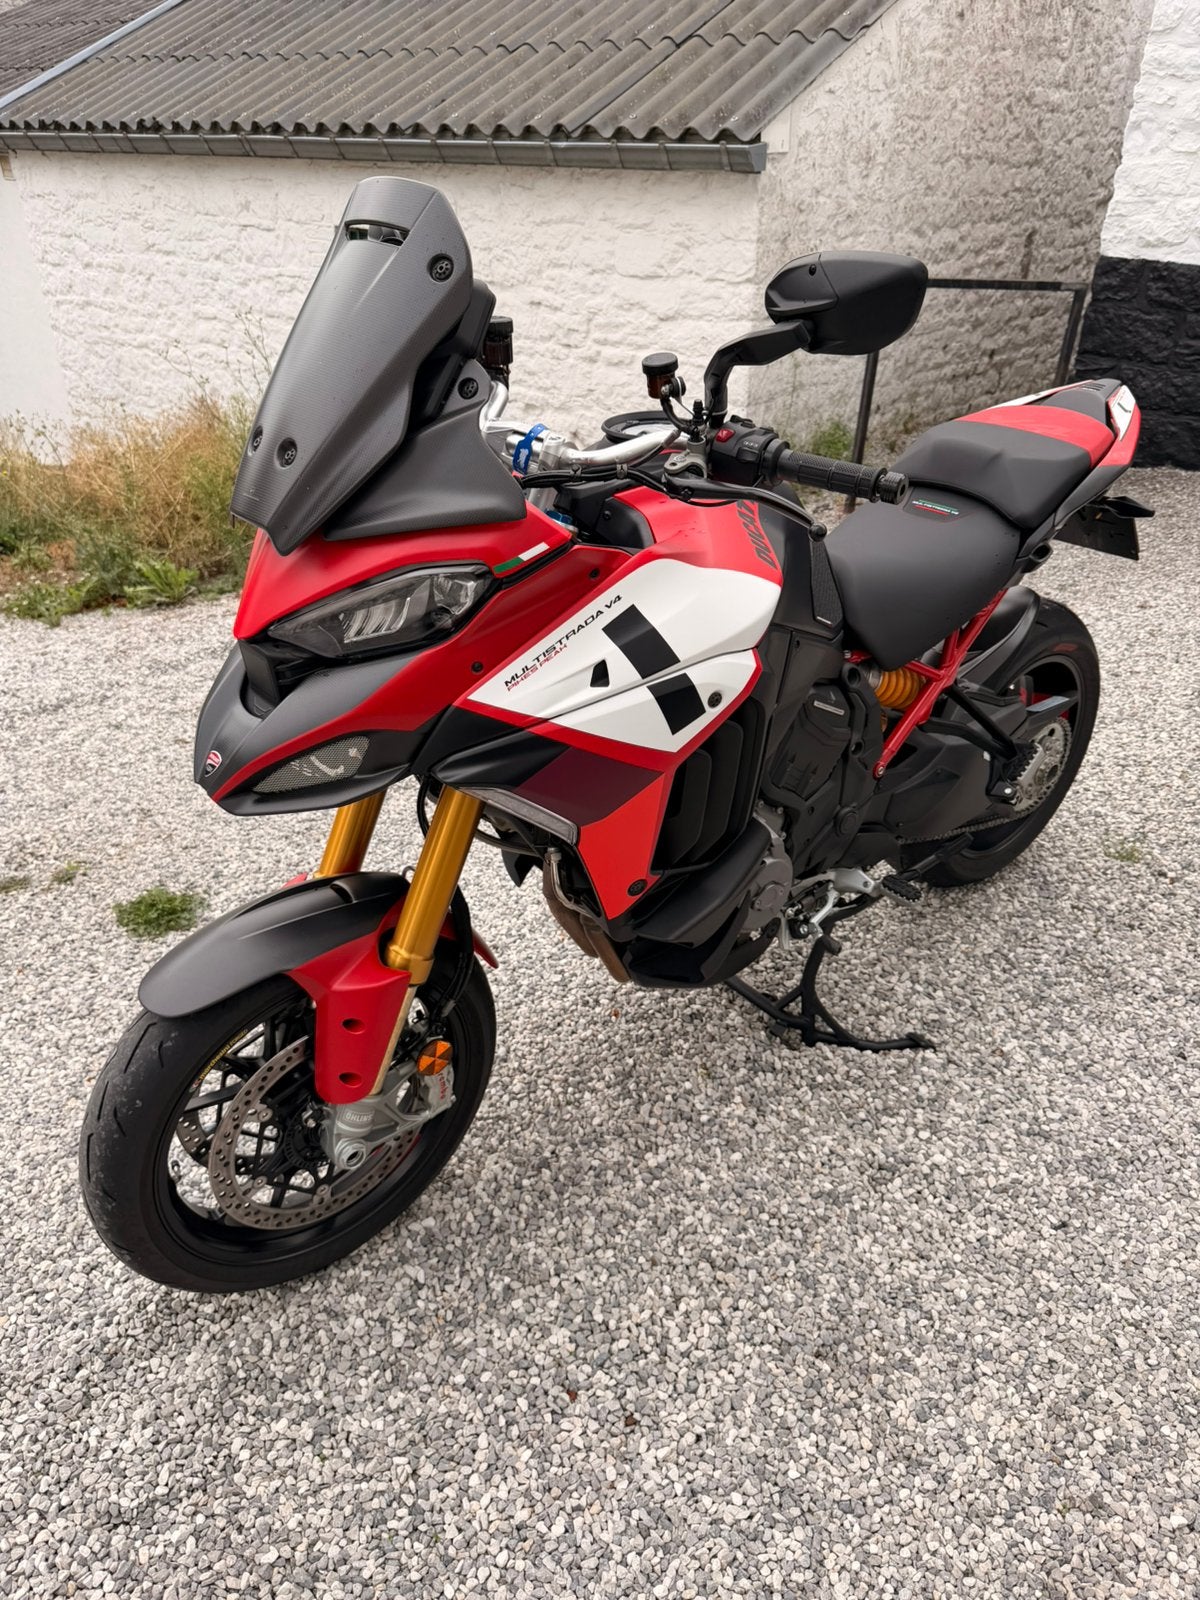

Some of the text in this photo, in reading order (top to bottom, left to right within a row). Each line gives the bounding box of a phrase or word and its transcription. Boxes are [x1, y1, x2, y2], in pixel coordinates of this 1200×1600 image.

[736, 499, 778, 570] DUCAT
[504, 594, 623, 687] MULTISTRADA V4
[438, 1072, 449, 1100] rembo
